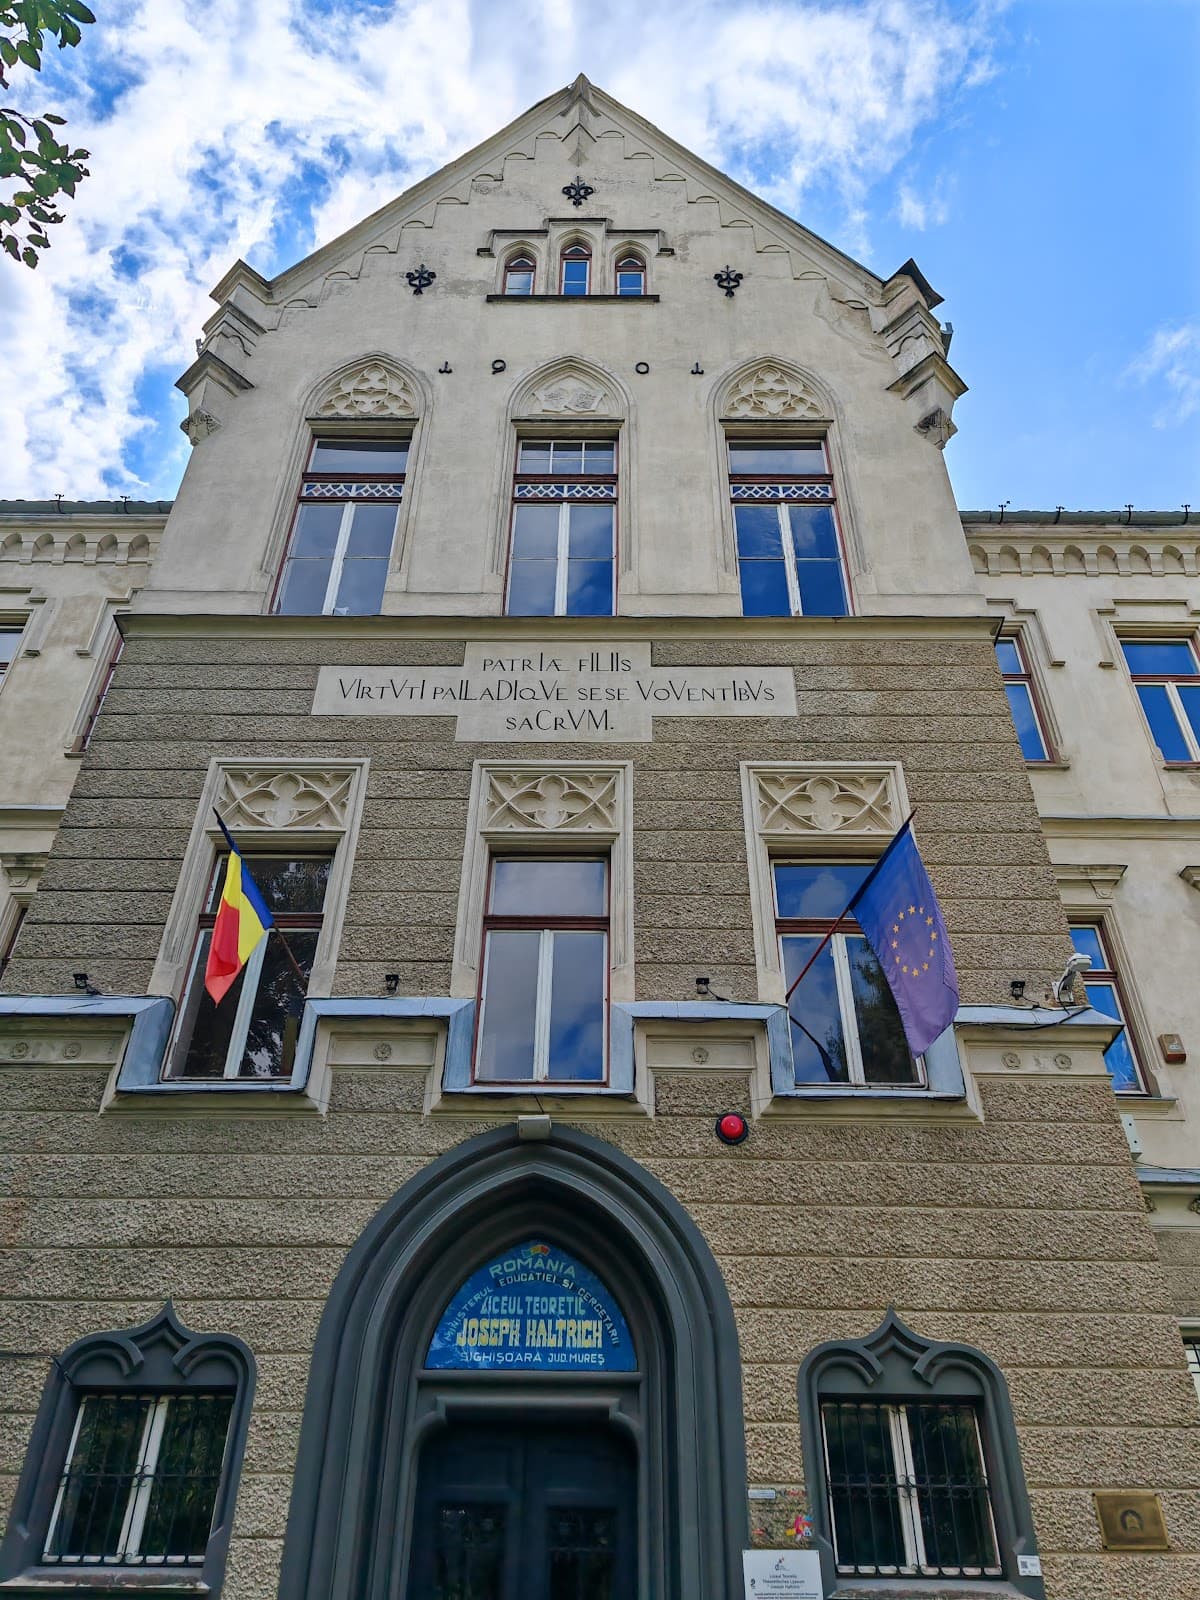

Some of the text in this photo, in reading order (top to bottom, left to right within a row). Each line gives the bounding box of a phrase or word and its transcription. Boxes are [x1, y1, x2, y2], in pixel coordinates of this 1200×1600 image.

[579, 652, 632, 671] FILIIS
[339, 679, 775, 701] VIRTVTI PALLADIQVE SESE VOVENTIBVS
[506, 709, 614, 731] SACRVM.
[480, 1296, 586, 1316] LICEUL TEORETIC
[456, 1318, 603, 1349] JOSEPH HALTRICH
